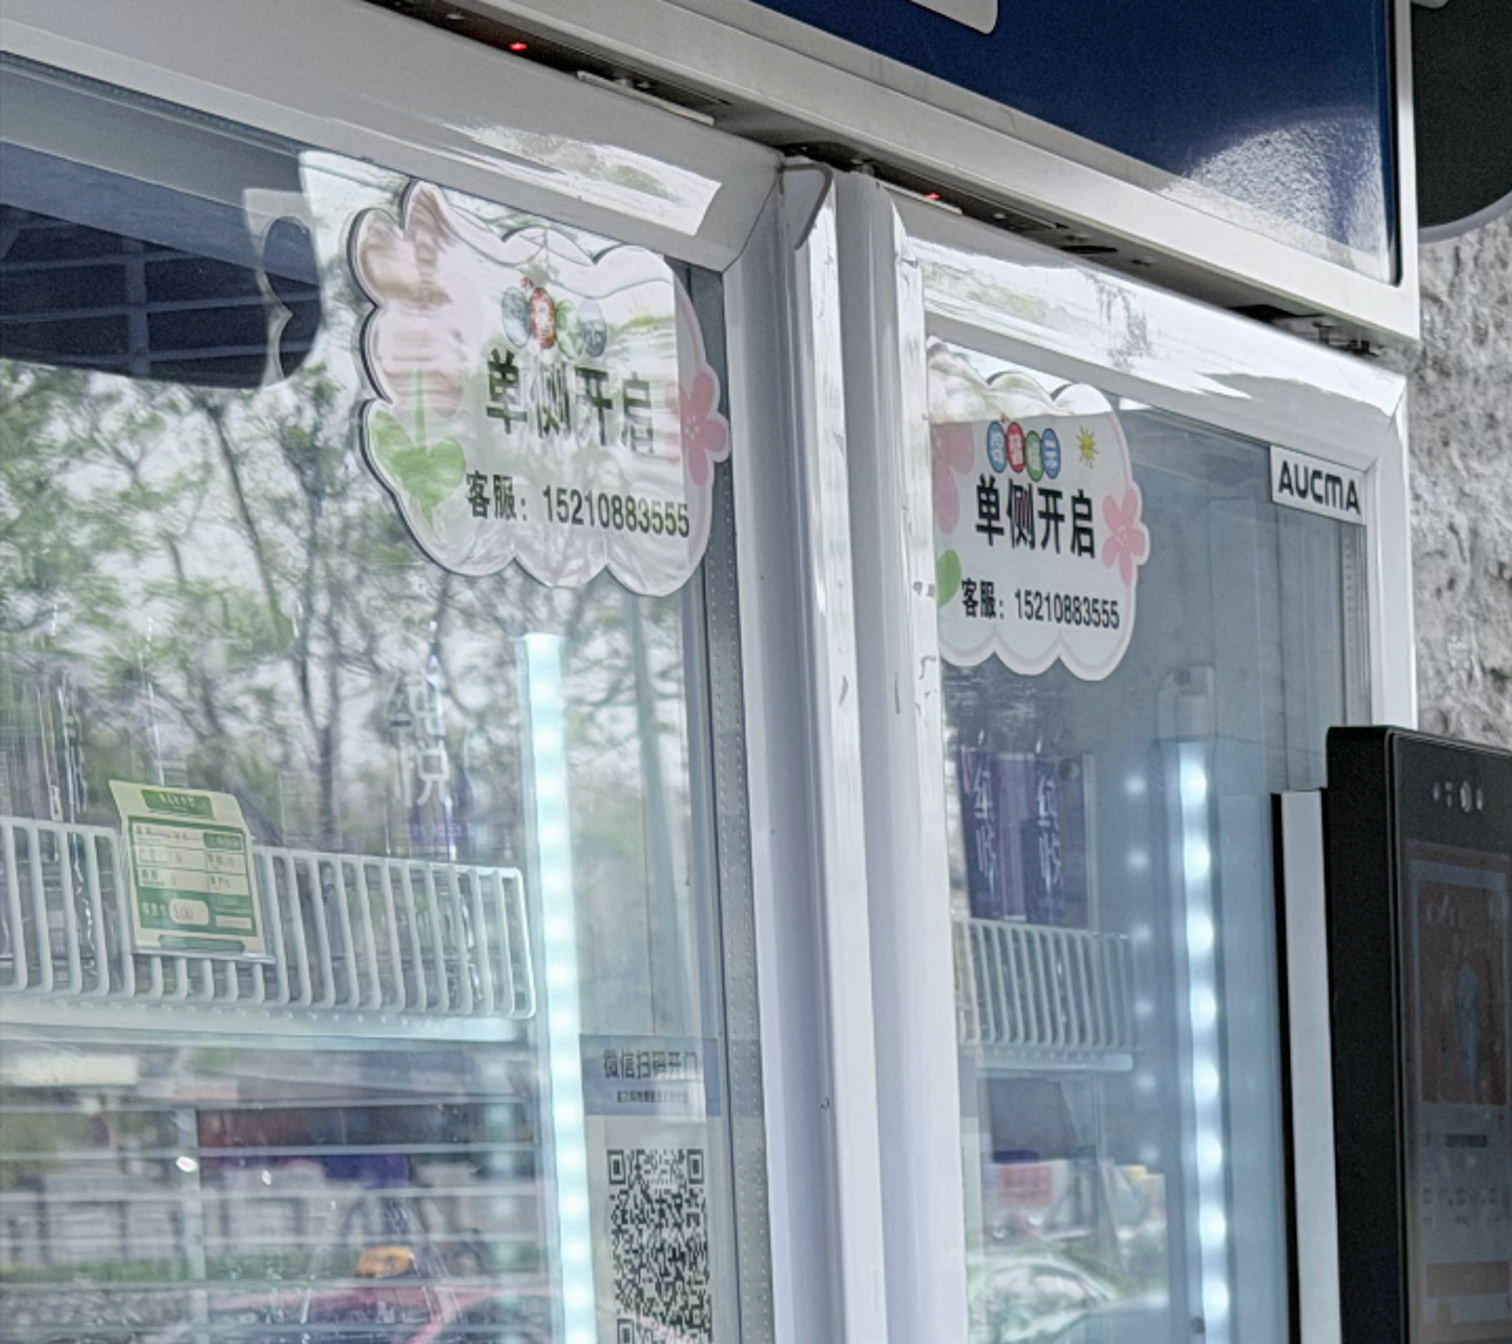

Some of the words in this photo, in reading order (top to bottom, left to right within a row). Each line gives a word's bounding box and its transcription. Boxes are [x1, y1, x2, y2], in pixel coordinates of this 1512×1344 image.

[485, 348, 654, 454] 单侧开启
[542, 484, 690, 538] 15210883555
[1278, 459, 1361, 515] AUCMA
[975, 472, 1096, 560] 单侧开启
[1014, 587, 1120, 630] 15210883555
[602, 1048, 700, 1081] 微信扫码开门
